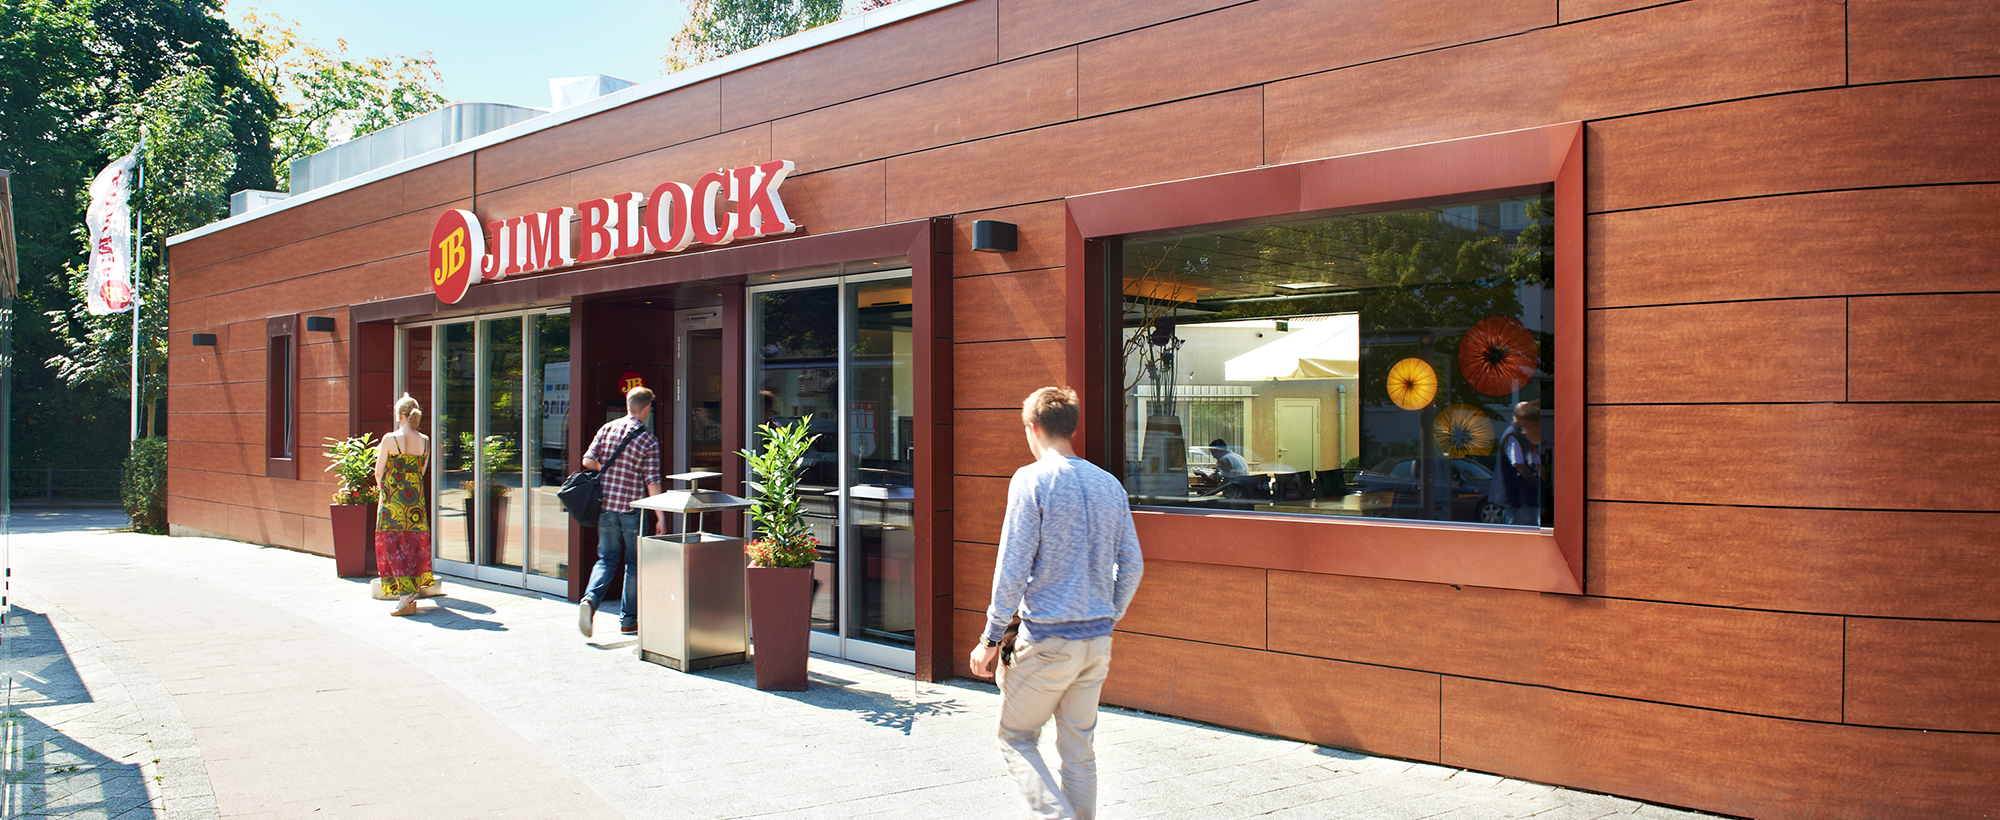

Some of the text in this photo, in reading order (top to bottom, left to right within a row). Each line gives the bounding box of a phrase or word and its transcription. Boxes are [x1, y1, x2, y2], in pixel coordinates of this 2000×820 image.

[481, 159, 791, 280] JIM BLOCK
[434, 226, 466, 286] JB
[622, 377, 643, 393] JB
